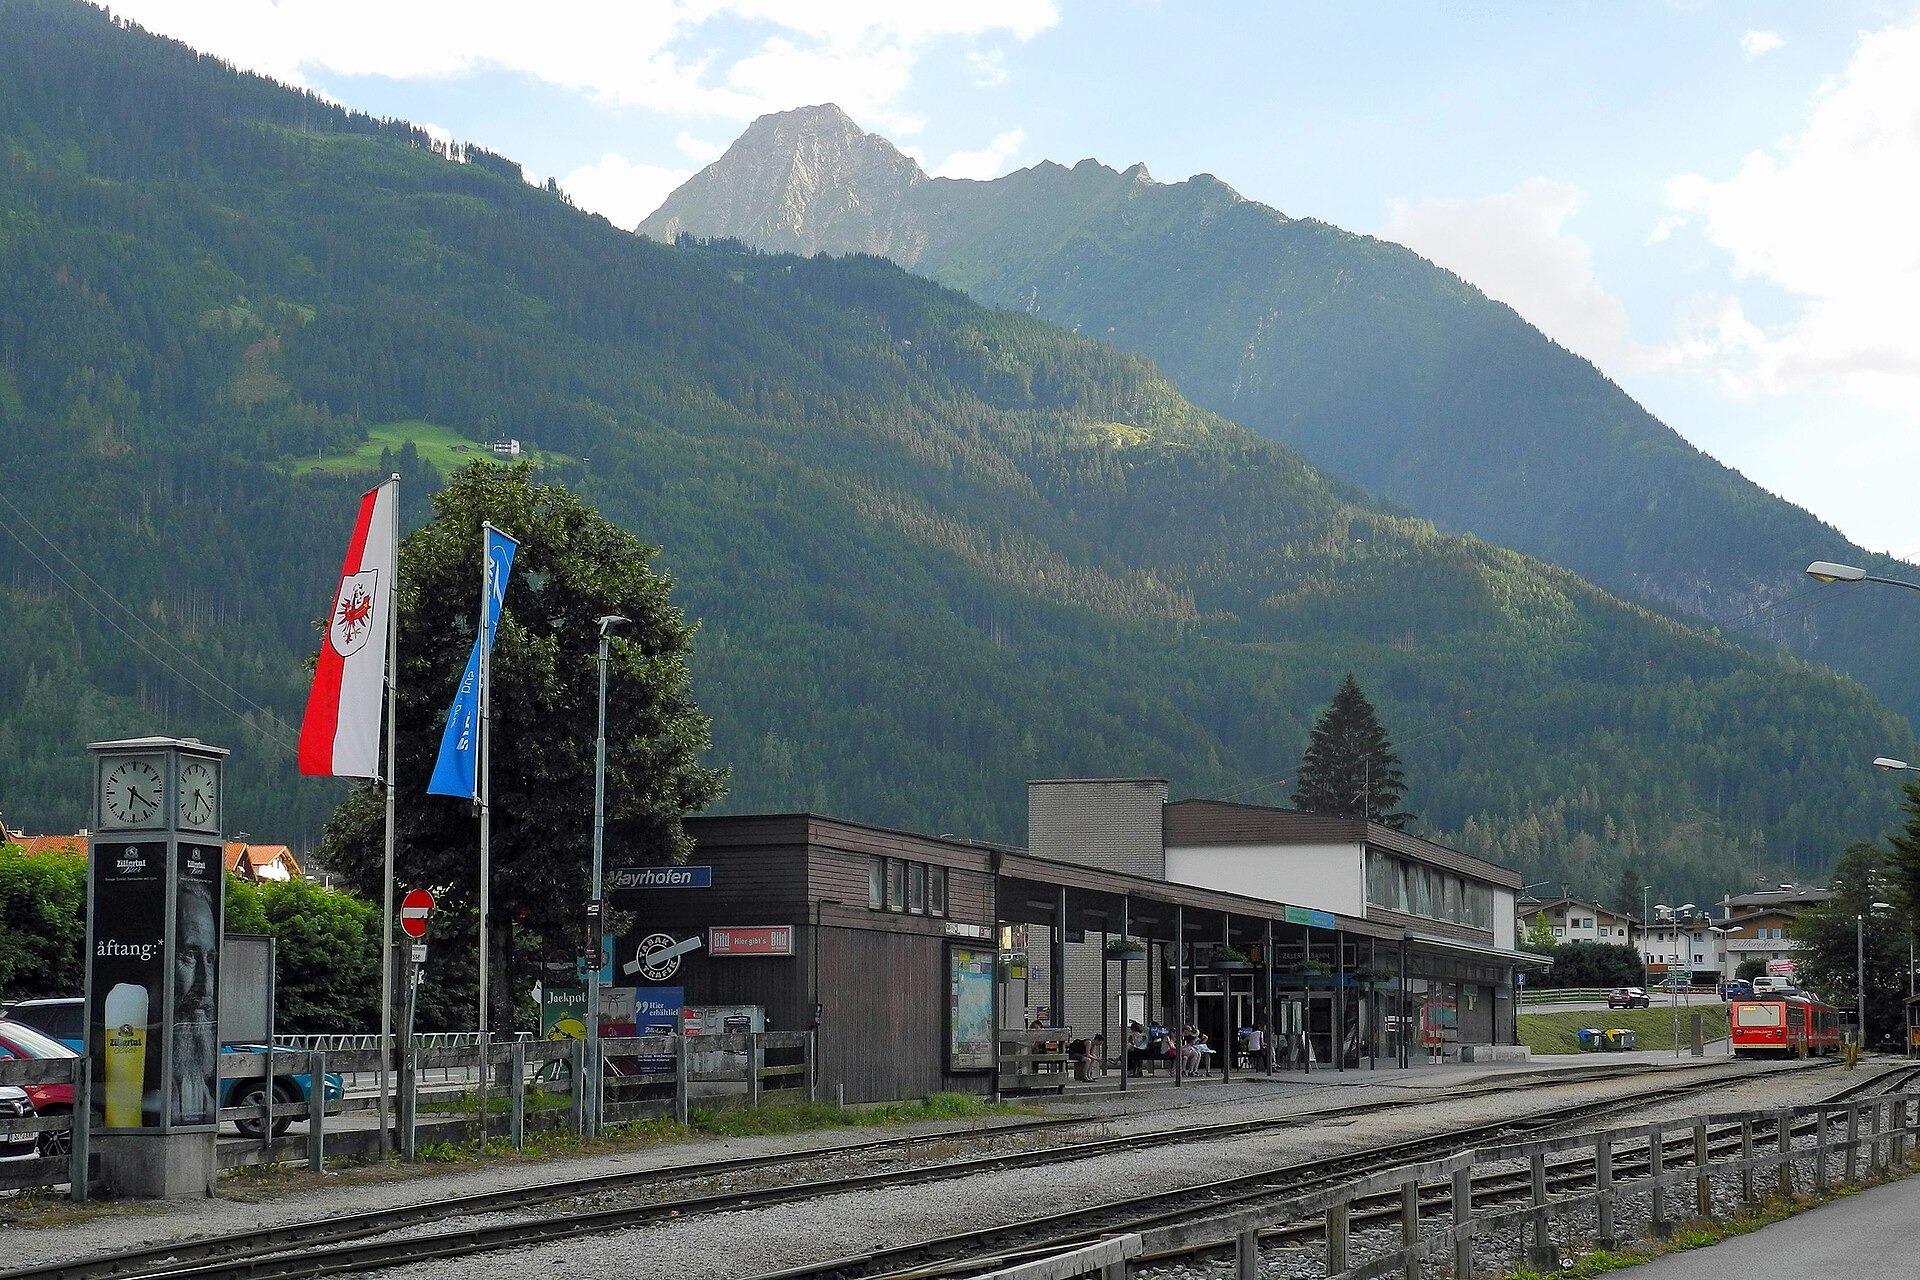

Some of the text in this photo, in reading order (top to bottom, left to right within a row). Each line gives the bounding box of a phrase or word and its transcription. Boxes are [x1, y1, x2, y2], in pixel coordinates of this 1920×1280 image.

[116, 859, 146, 868] Zillertal
[714, 932, 730, 947] Bild
[734, 937, 748, 945] Hier
[770, 931, 787, 947] Bild
[639, 937, 670, 958] TABAK
[1282, 952, 1330, 960] ZILLERTLBAHN
[642, 960, 677, 979] TRAFIK
[547, 991, 587, 1006] Jackpot
